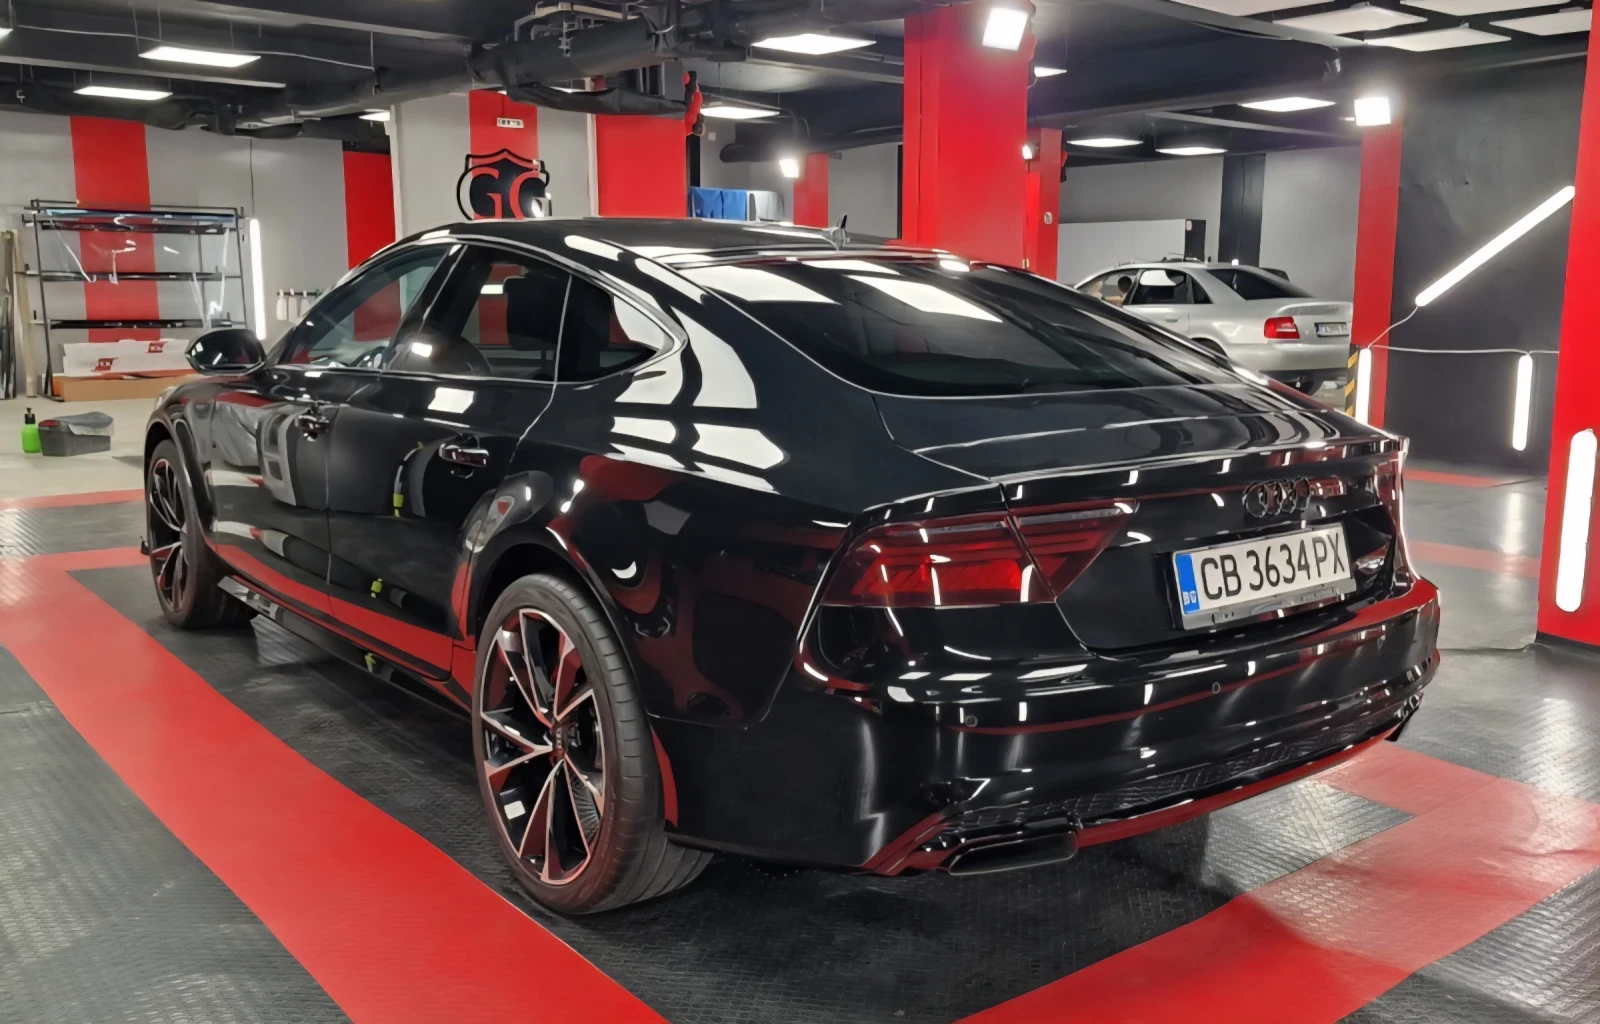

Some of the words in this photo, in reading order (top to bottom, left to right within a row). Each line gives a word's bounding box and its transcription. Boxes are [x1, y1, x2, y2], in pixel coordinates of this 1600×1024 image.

[1201, 554, 1242, 600] CB
[1246, 539, 1311, 591] 3634
[1312, 533, 1345, 578] PX
